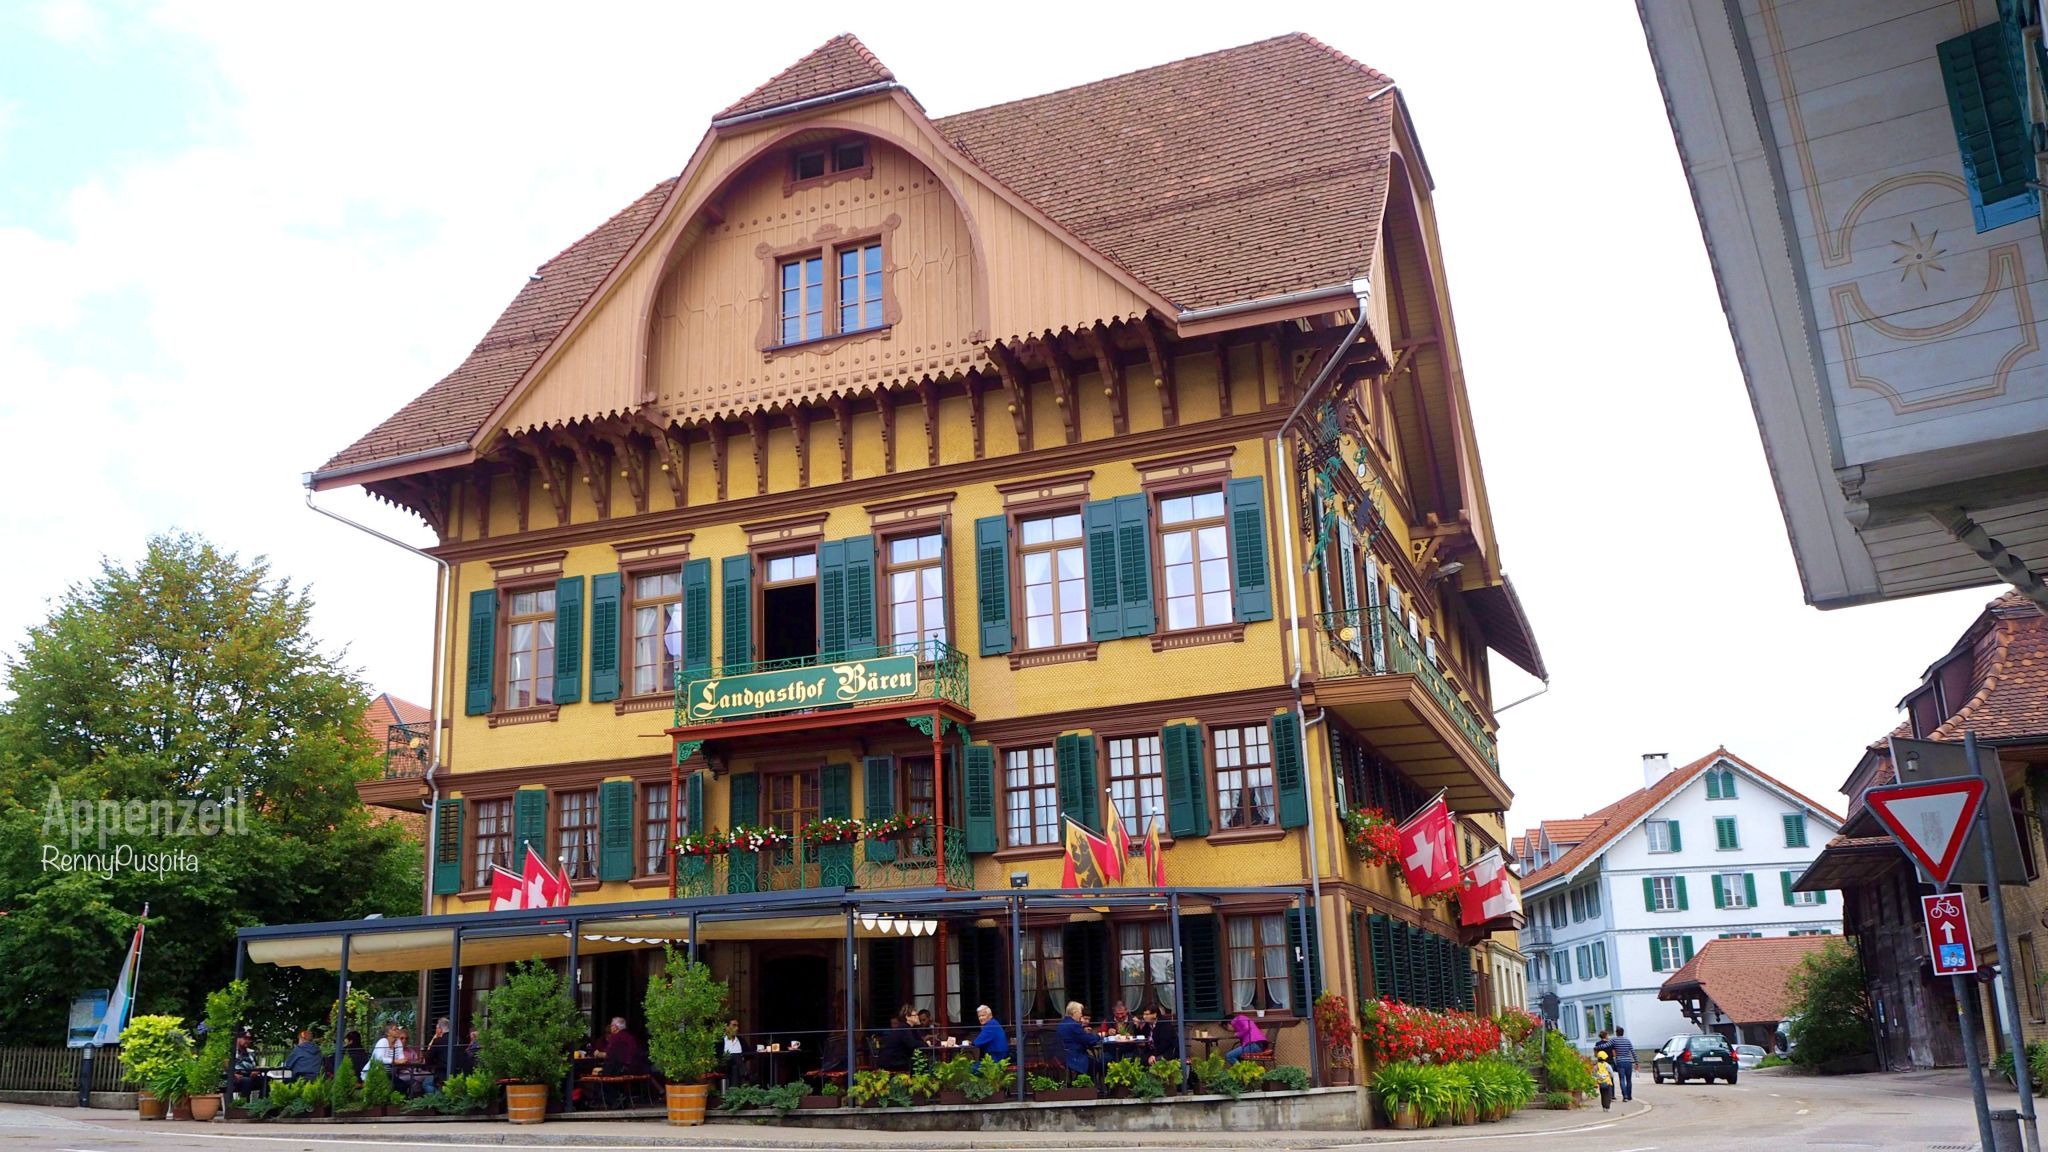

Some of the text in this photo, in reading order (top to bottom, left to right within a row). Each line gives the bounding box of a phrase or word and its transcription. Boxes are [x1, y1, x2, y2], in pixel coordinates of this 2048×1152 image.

[692, 663, 913, 718] Landgasthof Bären
[1943, 956, 1966, 967] 399
